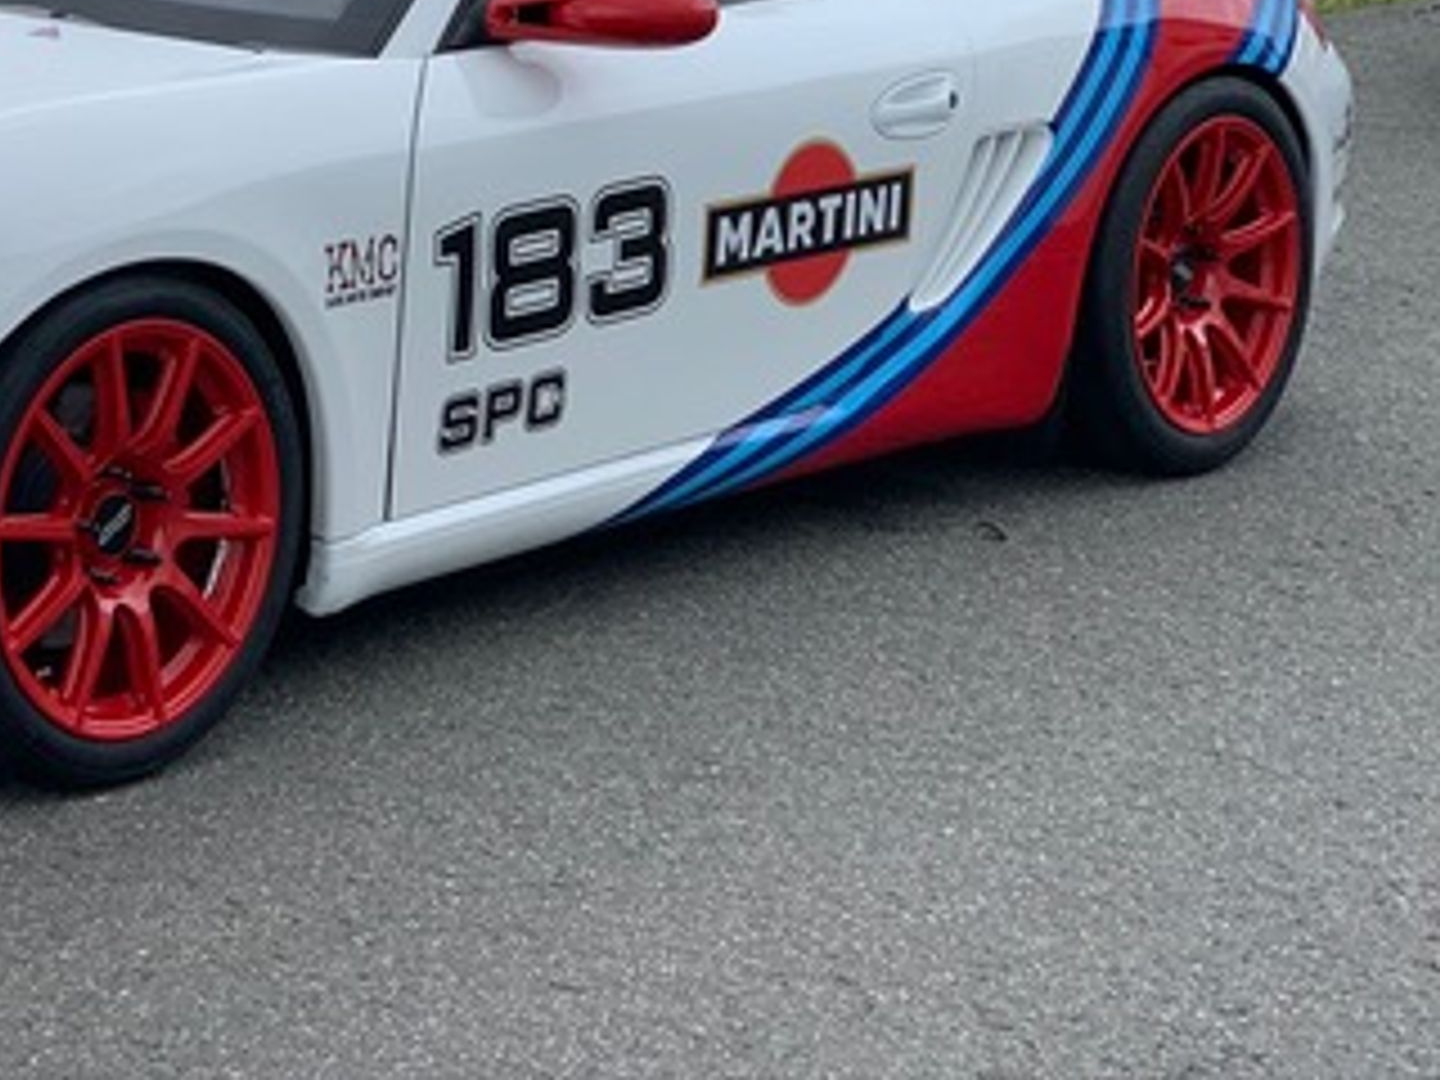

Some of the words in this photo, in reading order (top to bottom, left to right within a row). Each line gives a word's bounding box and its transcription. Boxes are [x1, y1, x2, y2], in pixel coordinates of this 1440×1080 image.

[324, 234, 398, 294] KMC
[713, 183, 904, 267] MARTINI
[433, 175, 672, 364] 183
[437, 368, 566, 455] SPC
